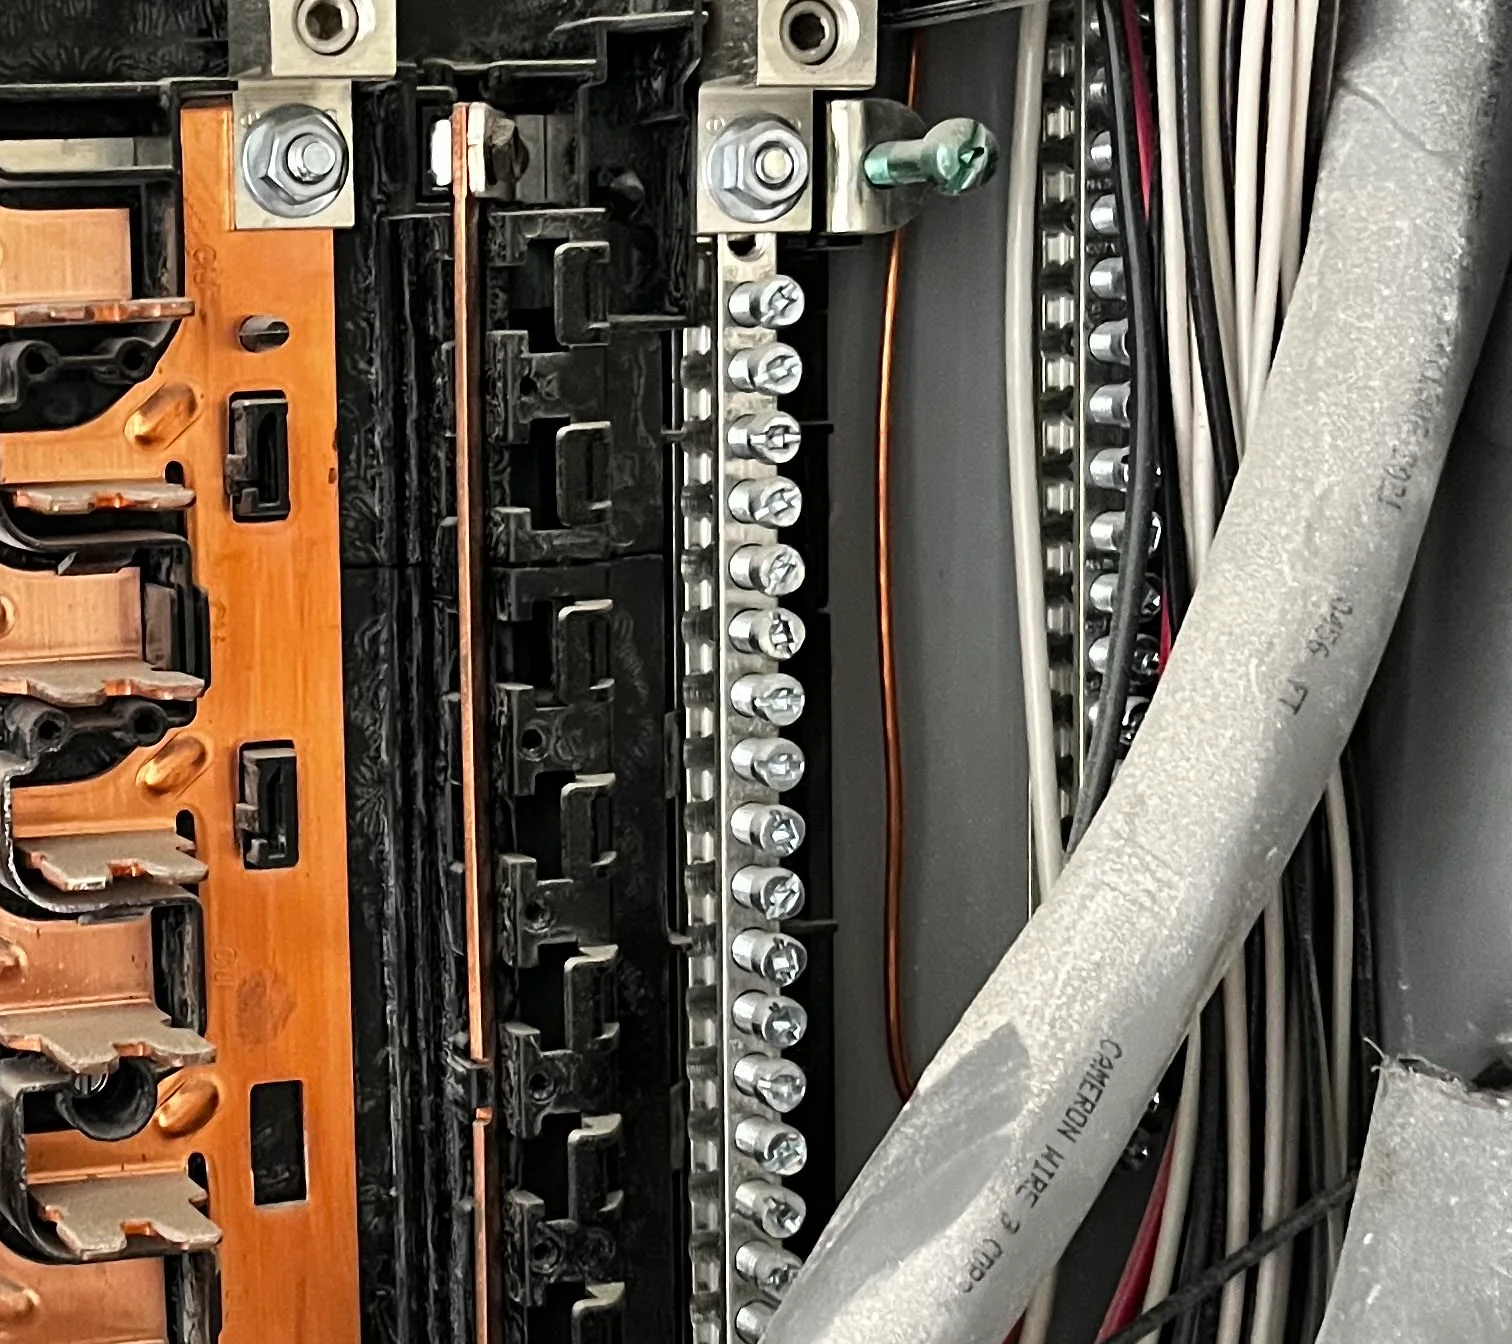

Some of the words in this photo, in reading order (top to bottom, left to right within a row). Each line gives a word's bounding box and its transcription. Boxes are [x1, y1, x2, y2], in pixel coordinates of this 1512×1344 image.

[1277, 682, 1309, 716] FT
[1057, 1038, 1123, 1143] CAMERON
[1015, 1142, 1063, 1209] WIRE
[1000, 1212, 1021, 1234] 3
